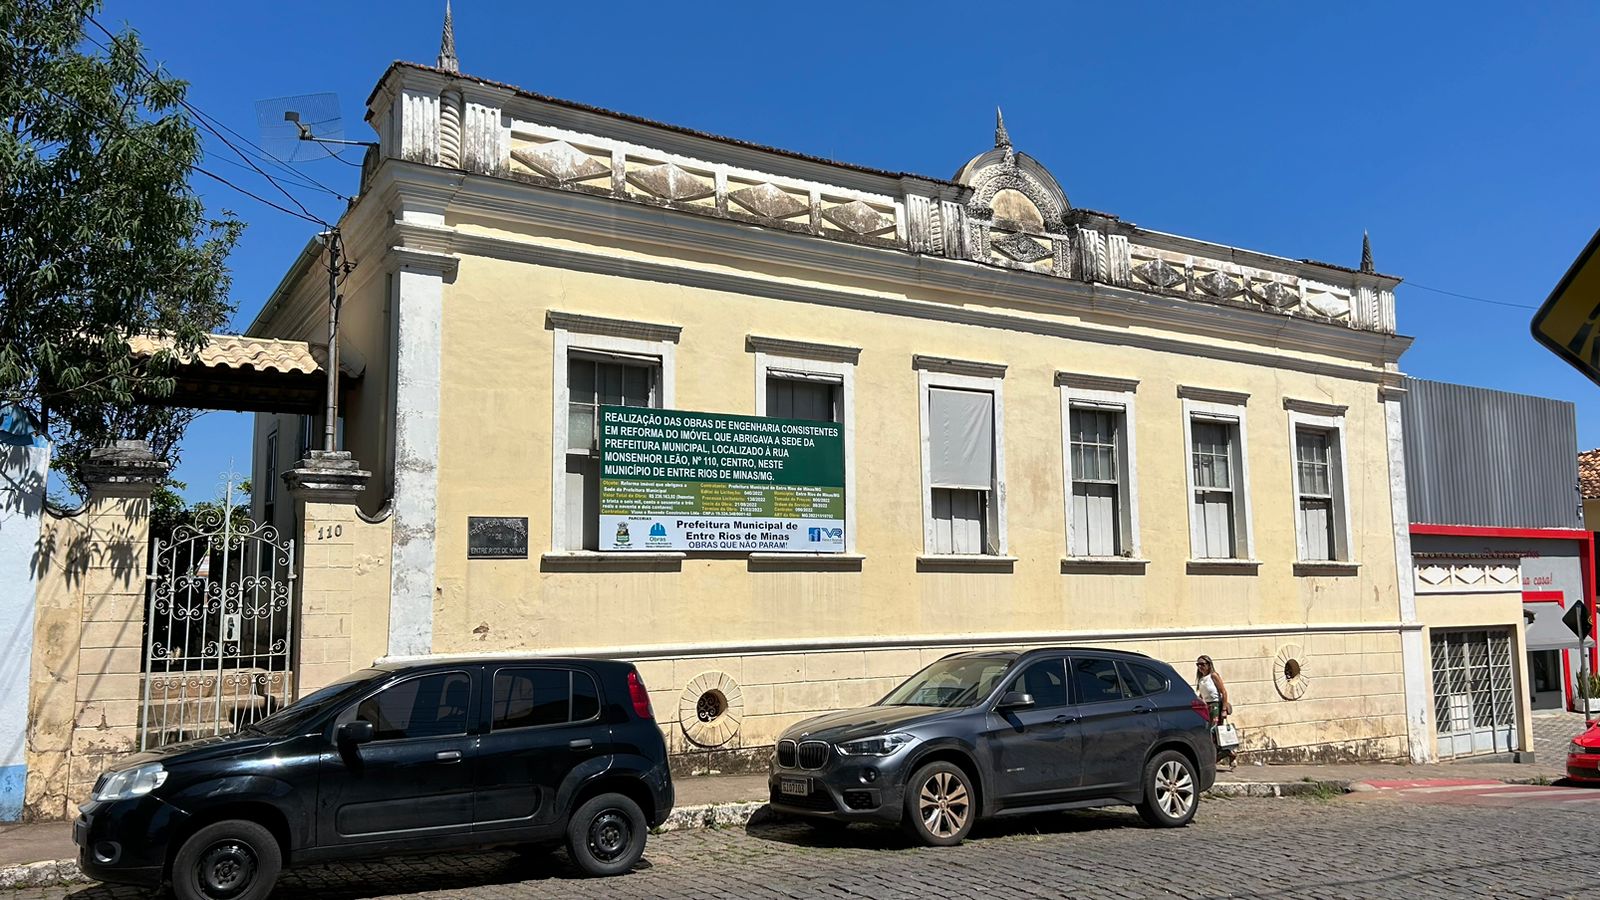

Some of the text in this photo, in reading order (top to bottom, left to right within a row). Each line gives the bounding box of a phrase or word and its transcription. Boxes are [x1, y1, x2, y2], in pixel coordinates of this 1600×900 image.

[605, 412, 838, 437] REALIZAÇÃO DAS OBRAS DE ENGENHARIA CONSISTENTES
[605, 426, 815, 447] EM REFORMA DO IMÓVEL QUE ABRIGAVA A SEDE DA
[605, 439, 789, 457] PREFEITURA MUNICIPAL, LOCALIZADO À RUA
[605, 452, 783, 469] MONSENHOR LEÃO, Nº 110, CENTRO, NESTE
[605, 464, 775, 480] MUNICÍPIO DE ENTRE RIOS DE MINAS/MG.
[318, 524, 342, 540] 110
[677, 521, 798, 531] Prefeitura Municipal de
[686, 532, 715, 540] Entre
[719, 532, 741, 540] Rios
